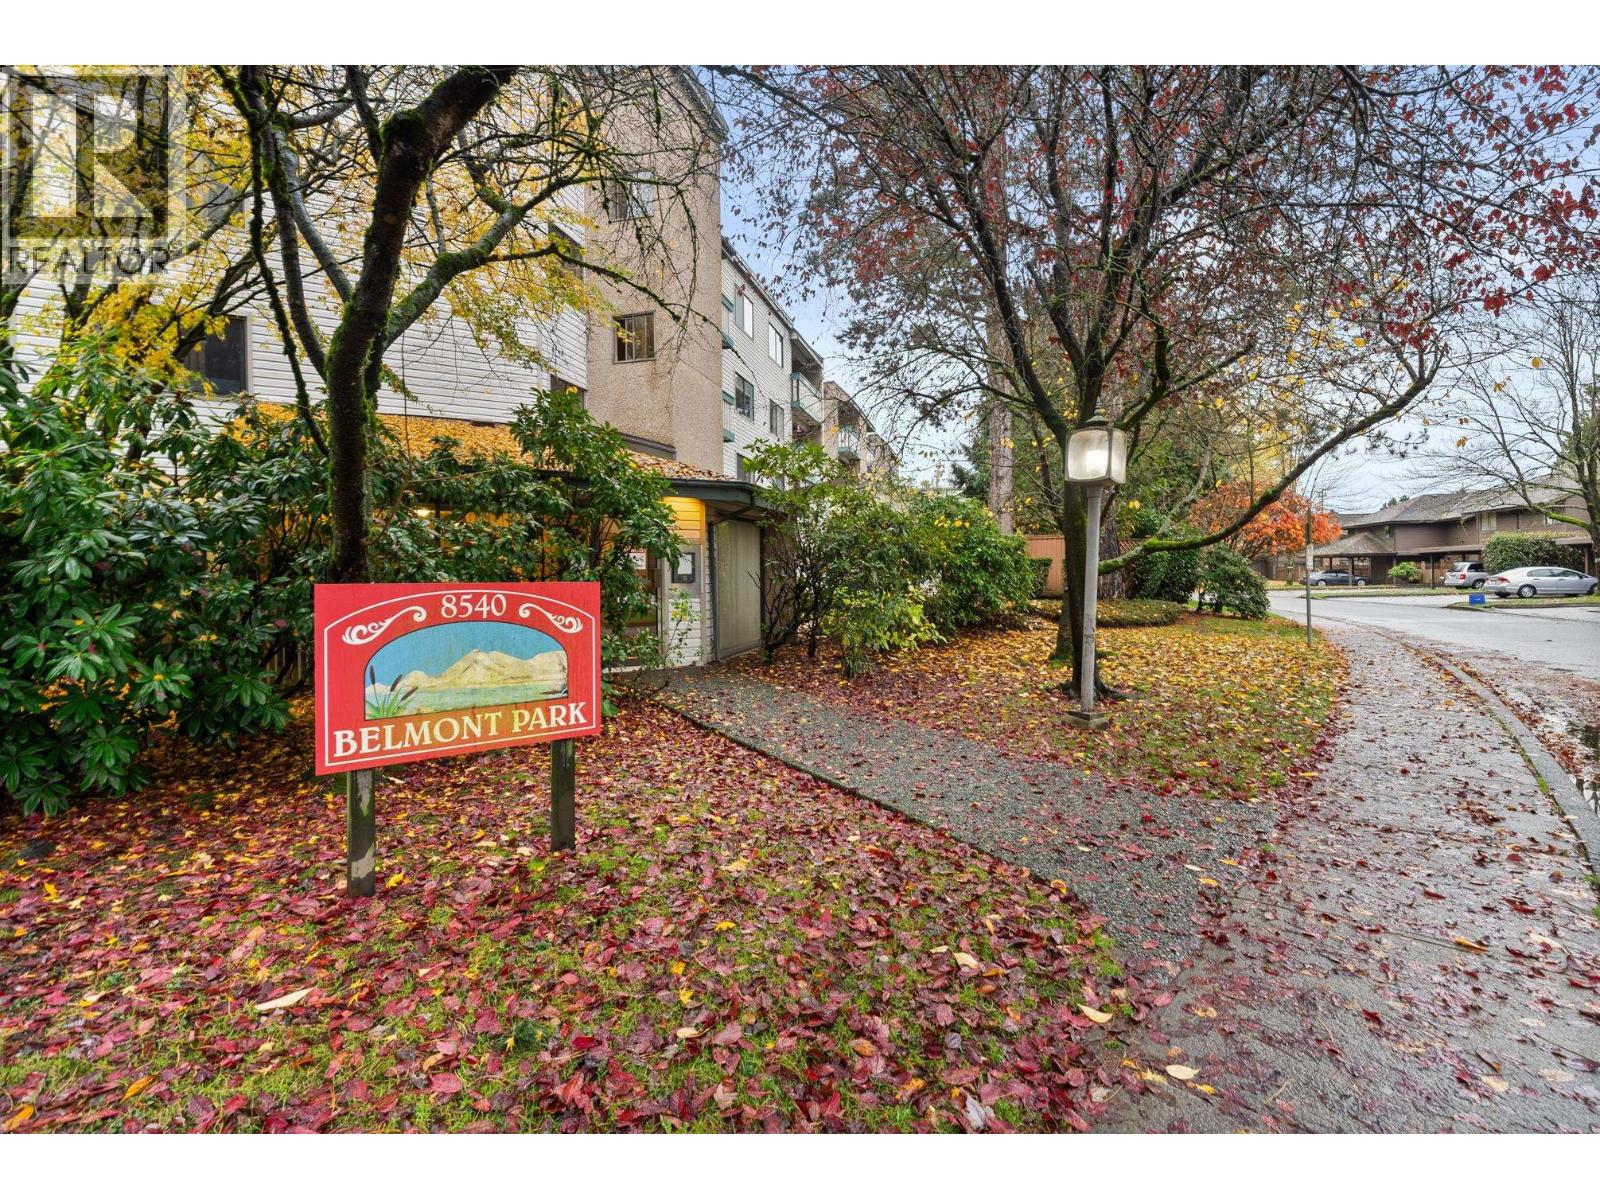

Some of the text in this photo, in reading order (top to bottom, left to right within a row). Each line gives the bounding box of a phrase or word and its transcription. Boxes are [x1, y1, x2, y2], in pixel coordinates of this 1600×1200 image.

[440, 593, 507, 619] 8540
[333, 701, 587, 758] BELMONT PARK
